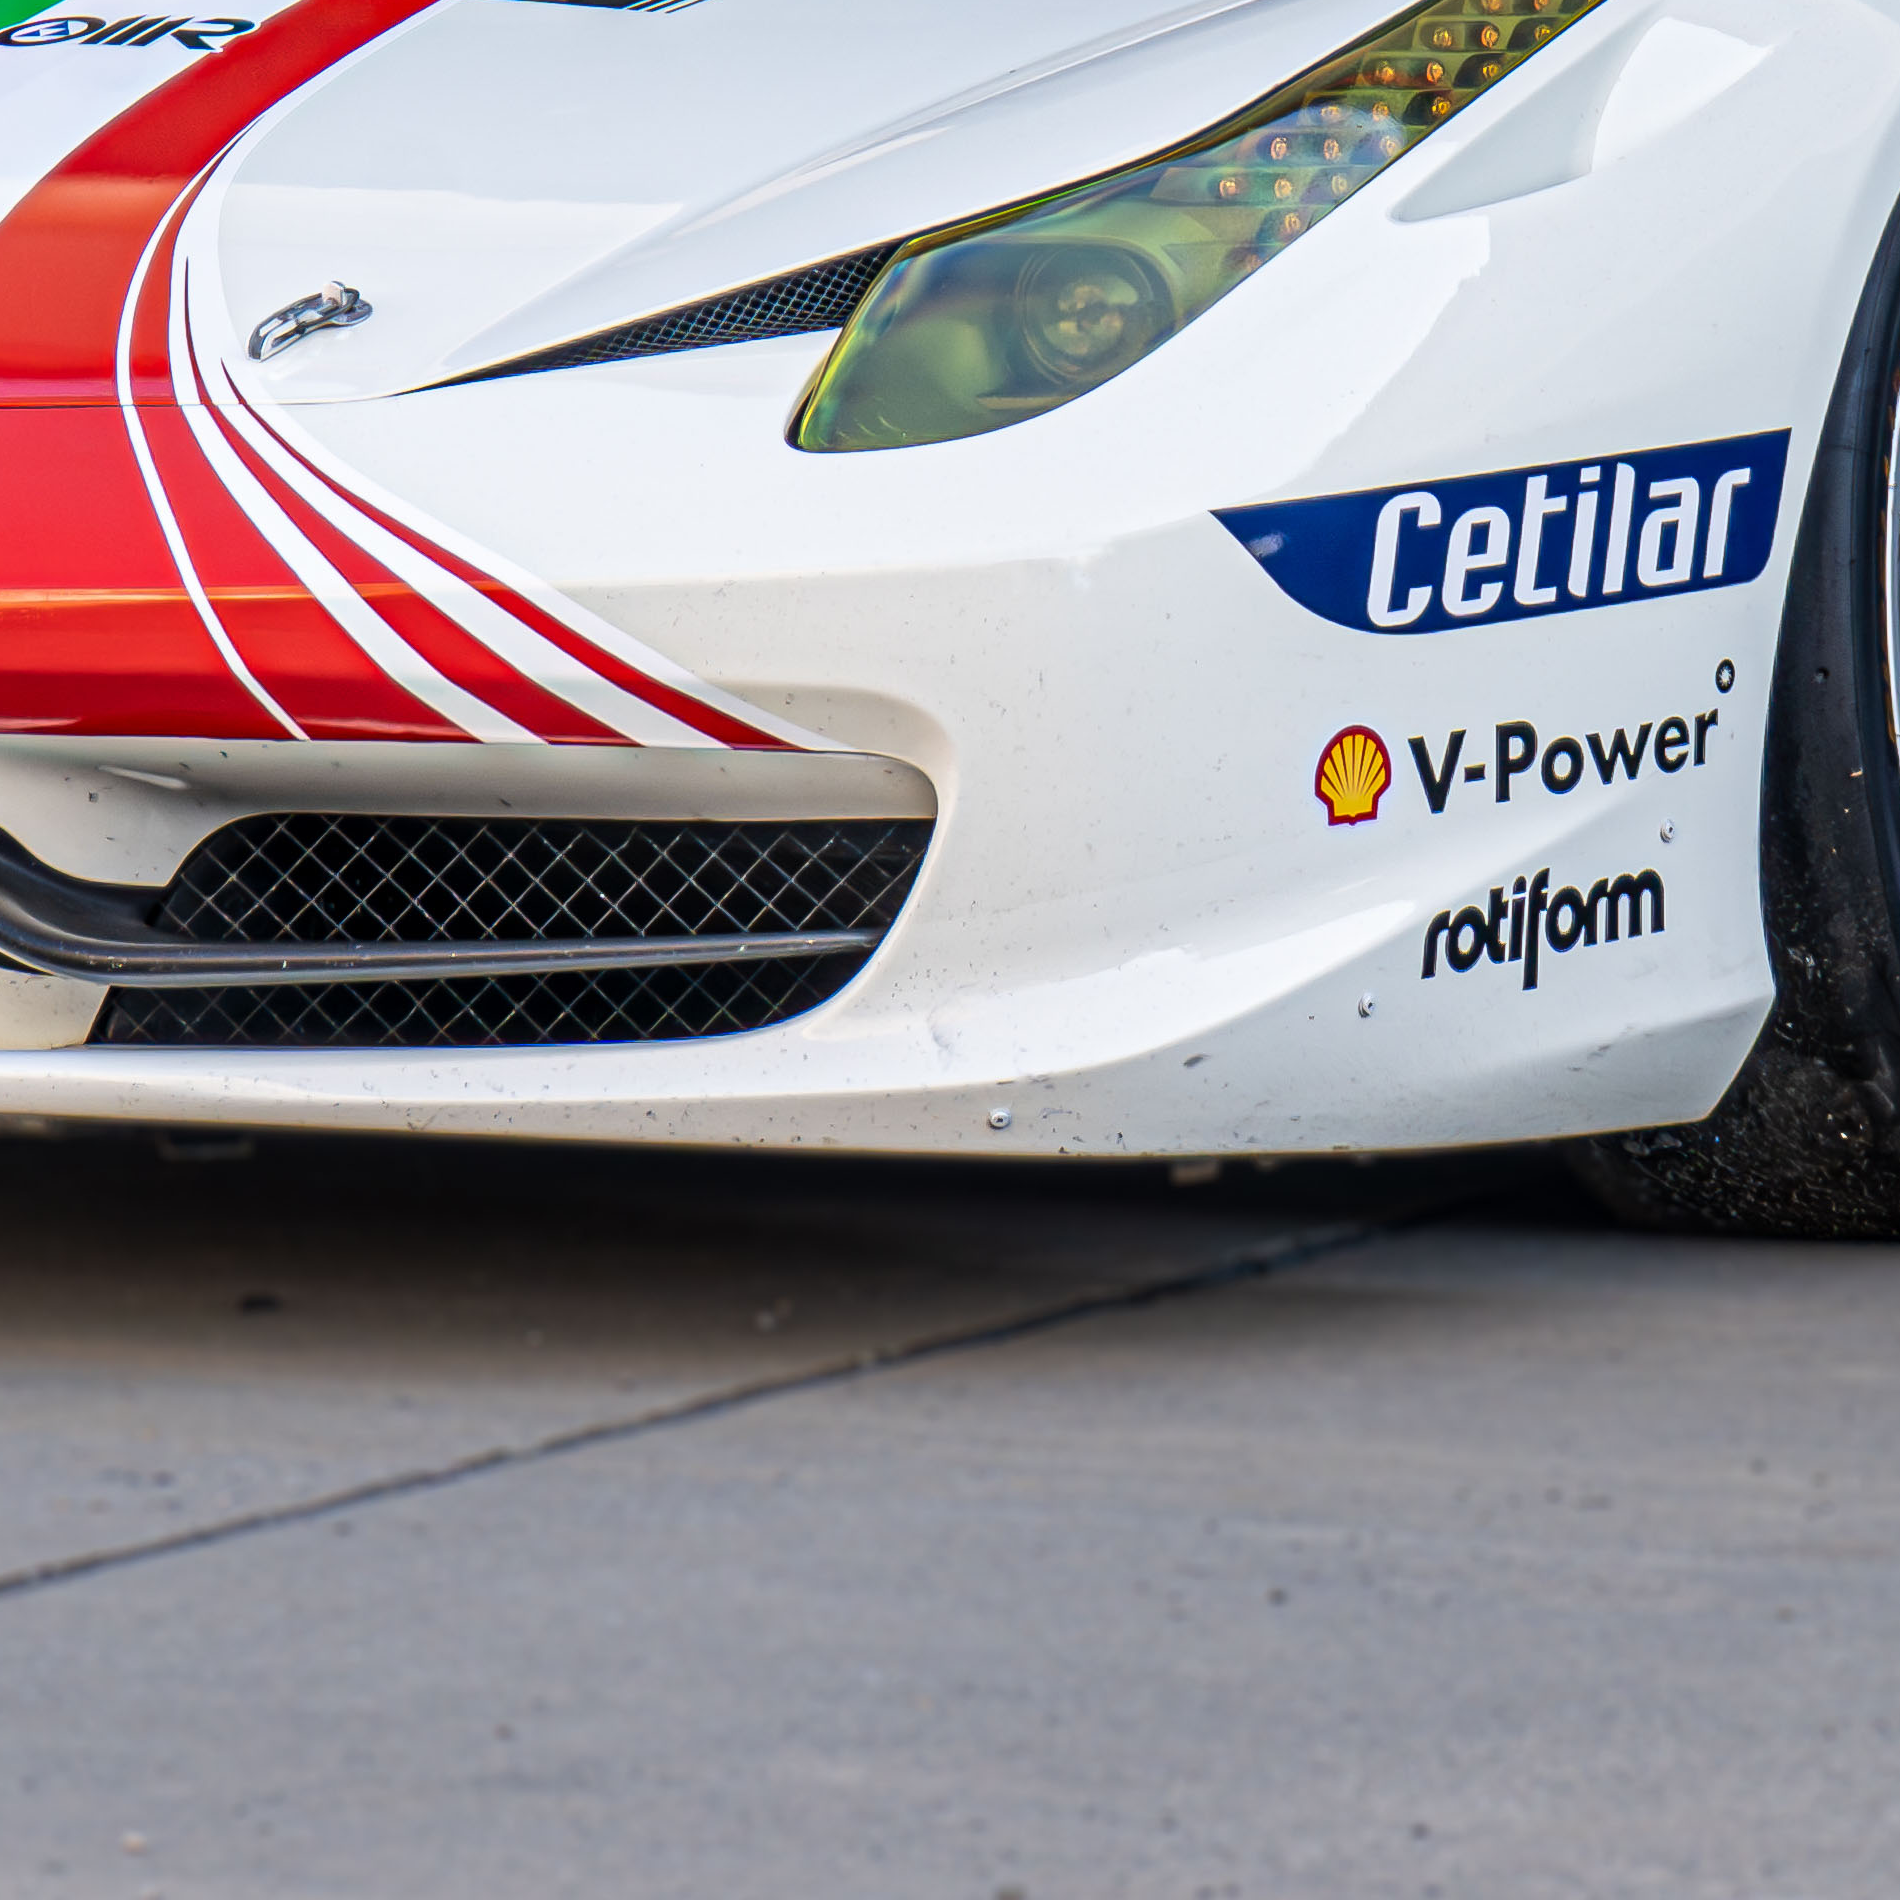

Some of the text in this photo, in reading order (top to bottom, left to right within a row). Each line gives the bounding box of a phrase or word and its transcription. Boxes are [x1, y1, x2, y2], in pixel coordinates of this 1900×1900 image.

[1366, 462, 1751, 627] Cetilar
[1408, 707, 1719, 815] V-Power
[1420, 867, 1666, 991] rotiform
